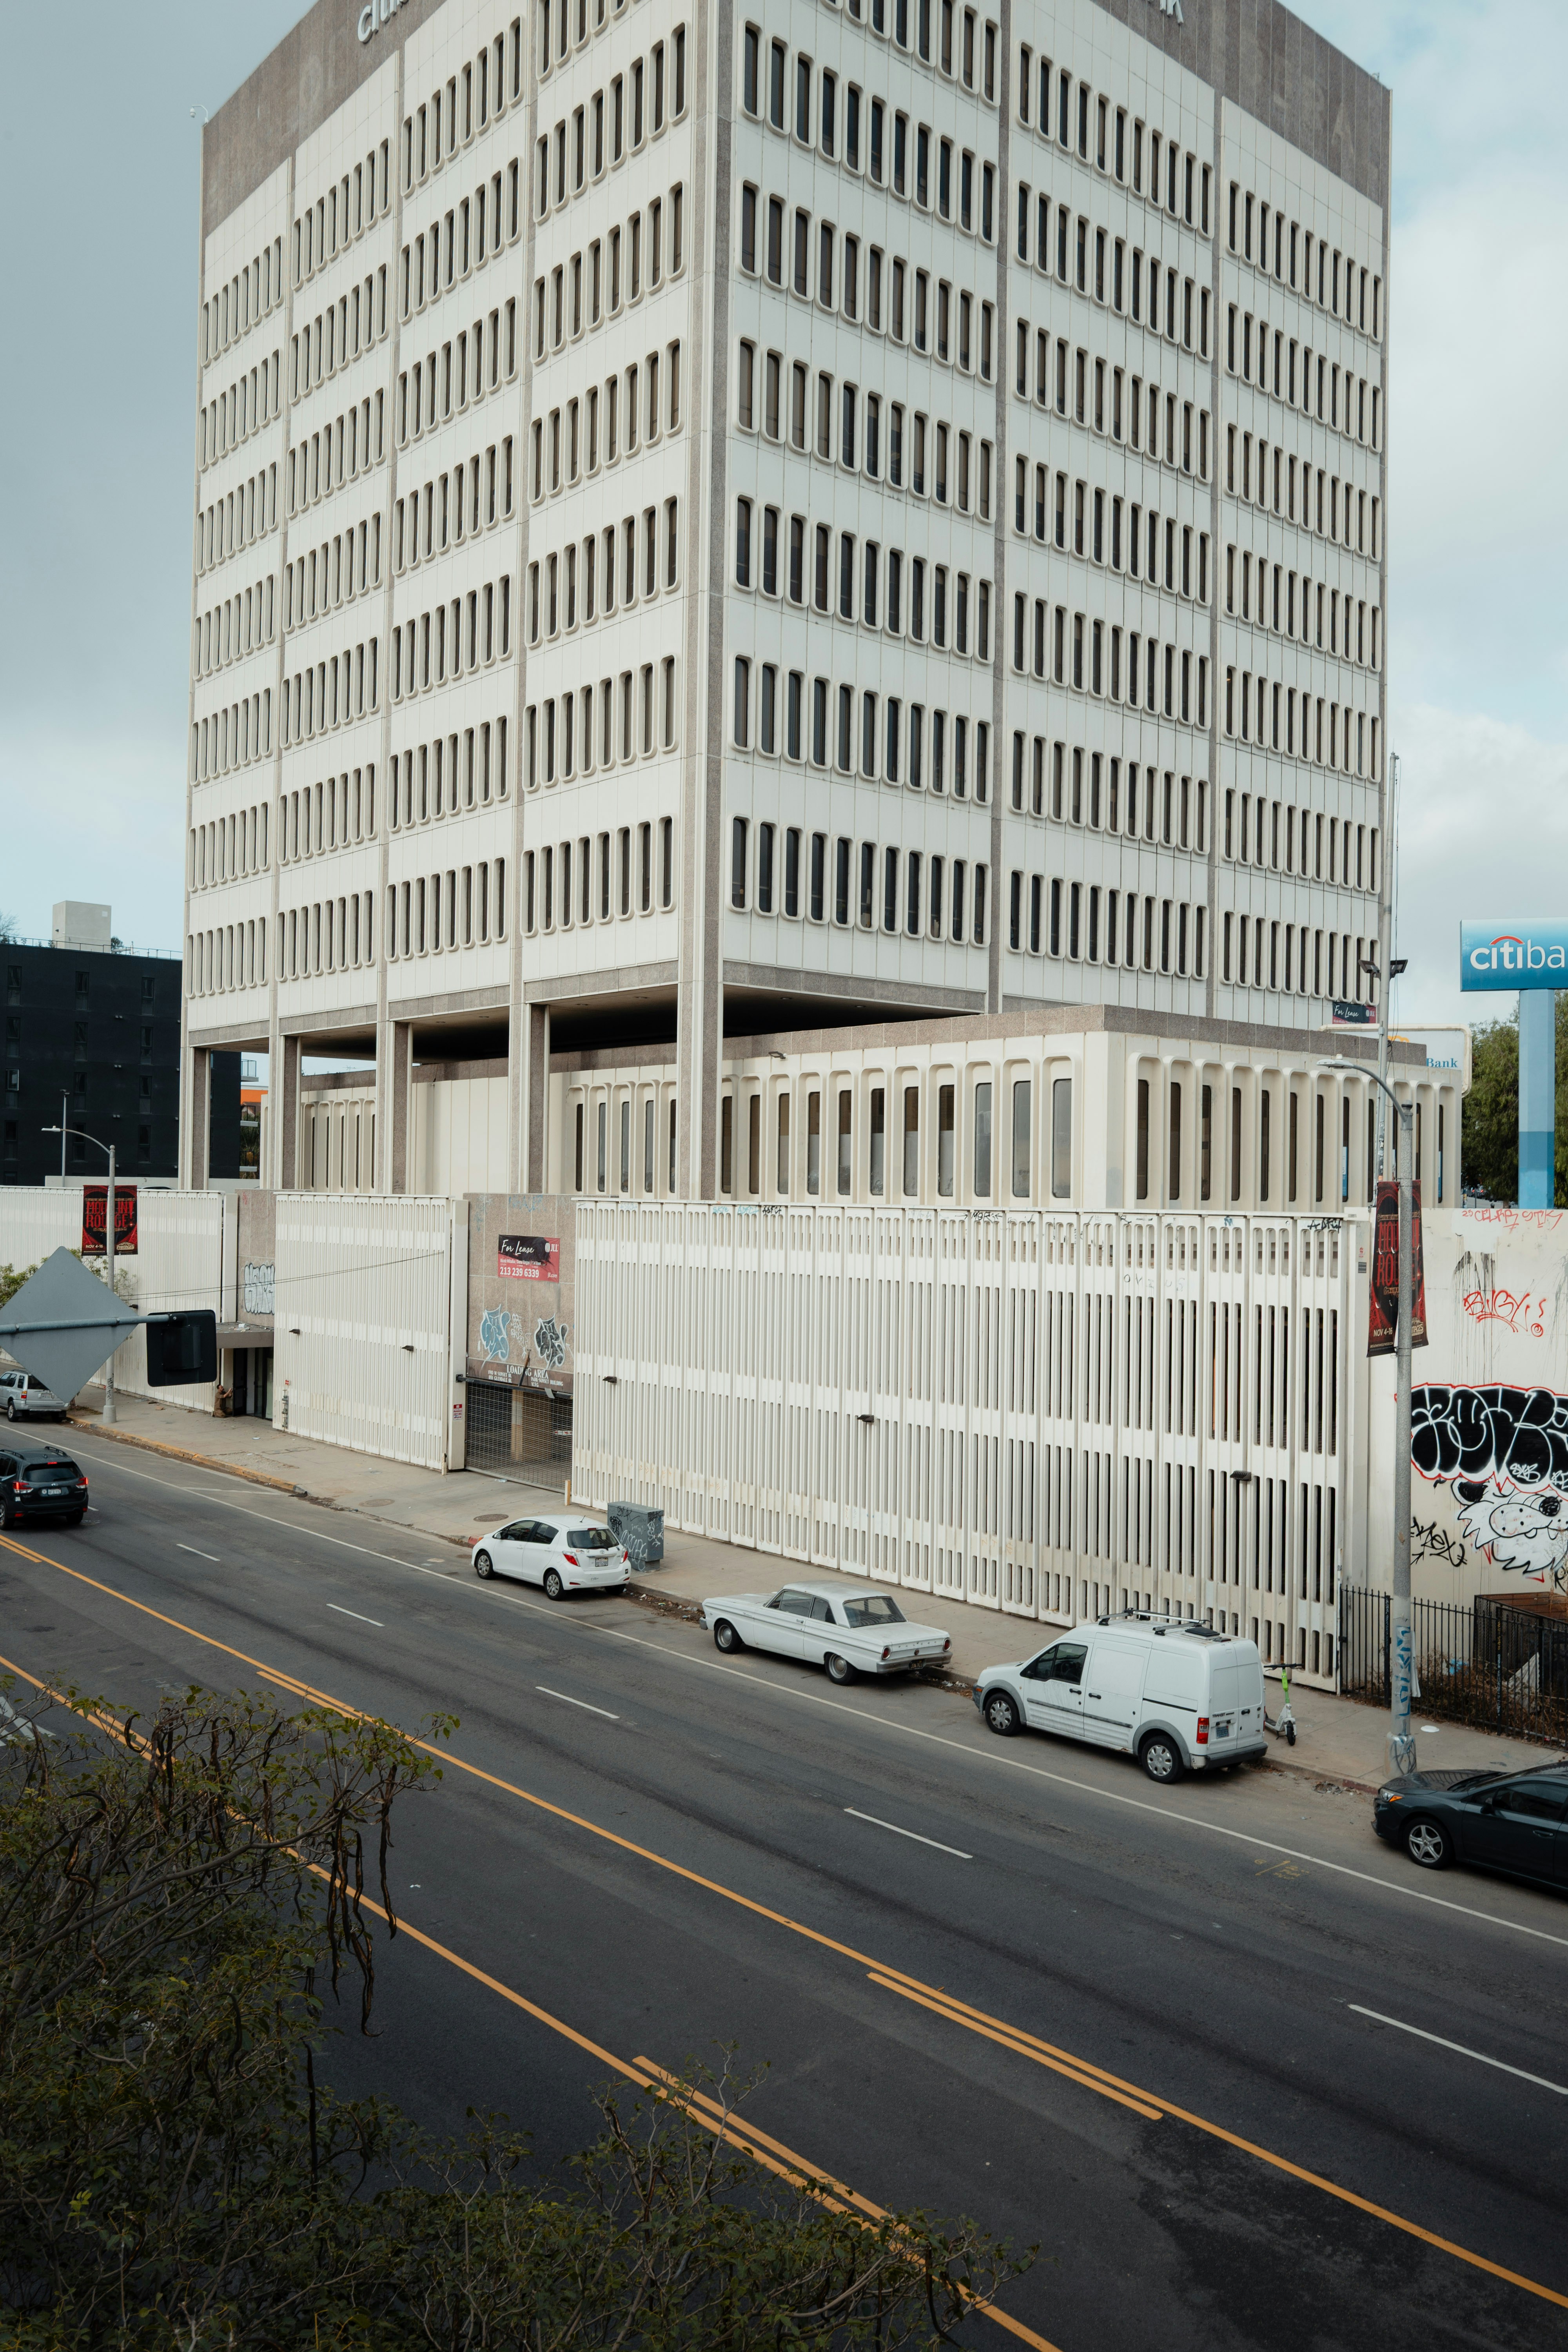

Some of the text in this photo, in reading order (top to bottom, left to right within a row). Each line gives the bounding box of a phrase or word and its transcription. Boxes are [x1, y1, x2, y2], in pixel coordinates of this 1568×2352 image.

[1470, 938, 1565, 970] citiba
[1334, 1005, 1359, 1018] For Lease
[1426, 1058, 1458, 1068] Bank
[501, 1239, 534, 1255] For Lease
[550, 1244, 559, 1252] JLL
[500, 1267, 539, 1278] 213 239 6339
[1373, 1327, 1393, 1337] NOV 4-16
[534, 1369, 549, 1379] AREA
